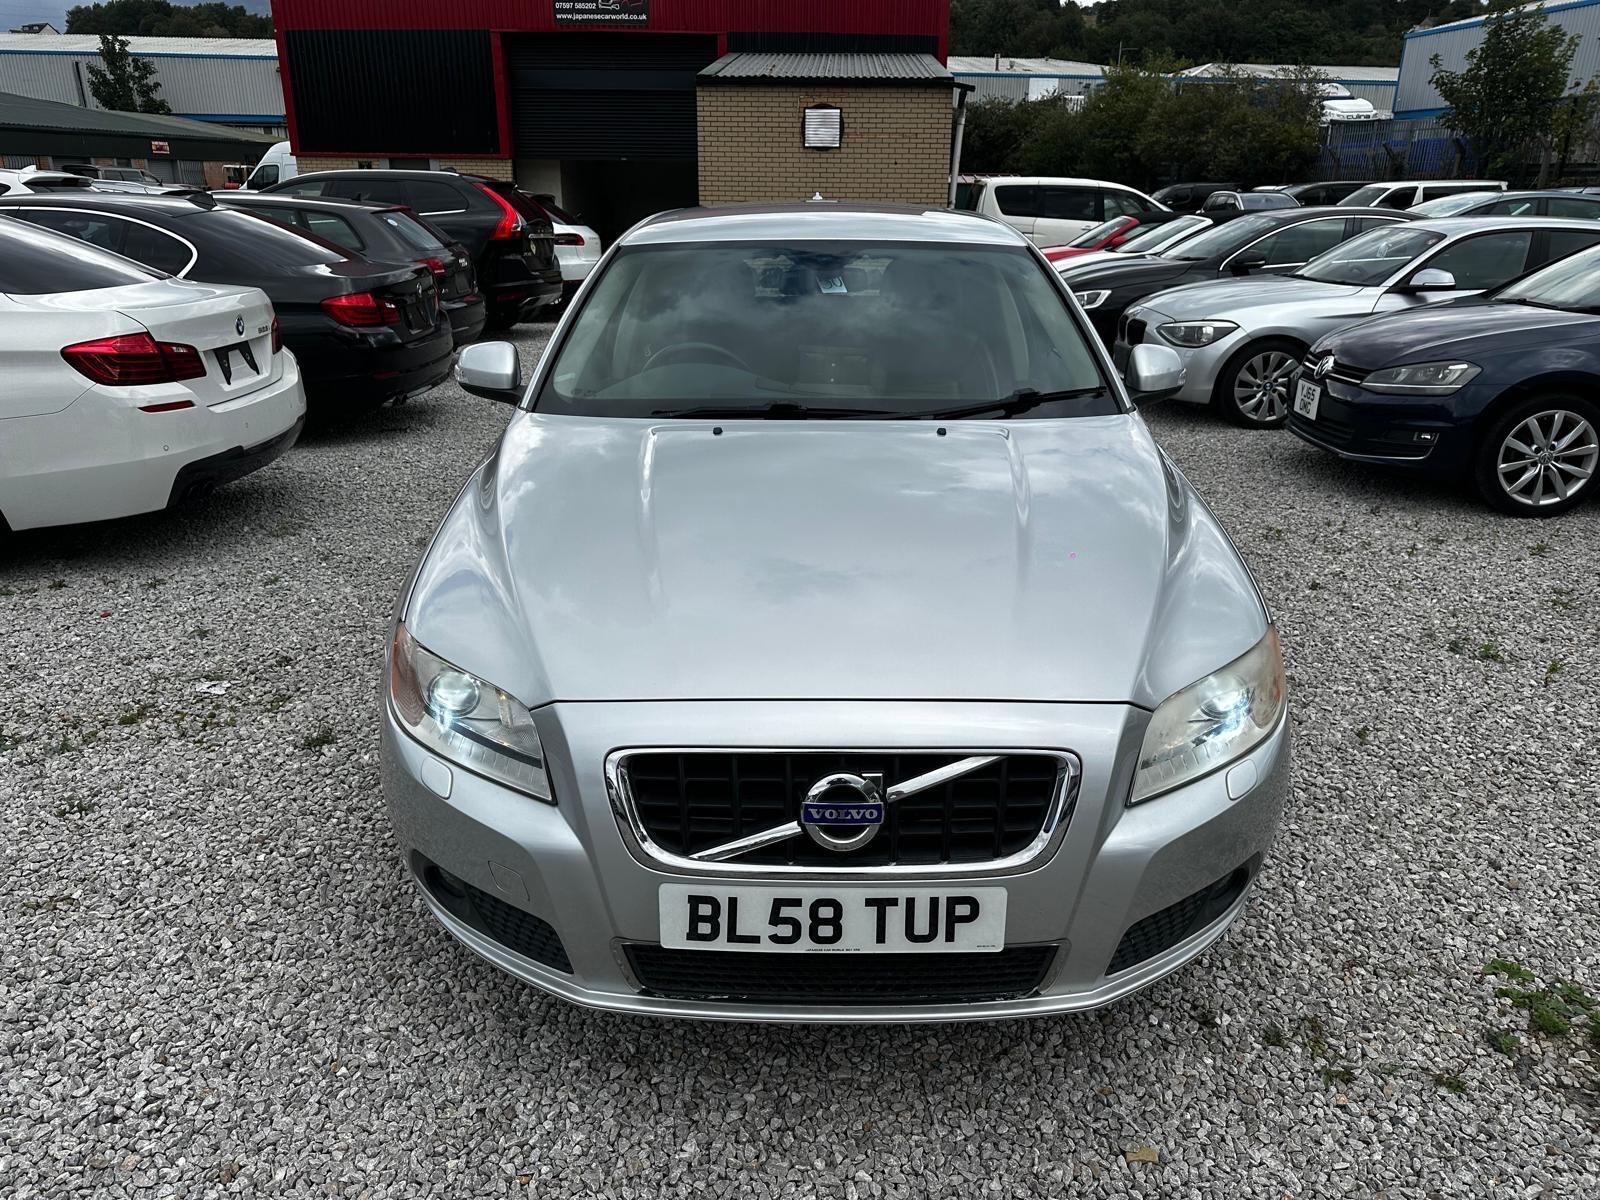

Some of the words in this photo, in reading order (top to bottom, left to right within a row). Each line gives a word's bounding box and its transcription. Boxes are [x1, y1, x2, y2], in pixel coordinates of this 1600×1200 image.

[556, 12, 647, 20] www.japanesecarworld.co.uk
[807, 808, 878, 820] VOLVO
[685, 894, 844, 945] BL58
[864, 895, 980, 945] TUP
